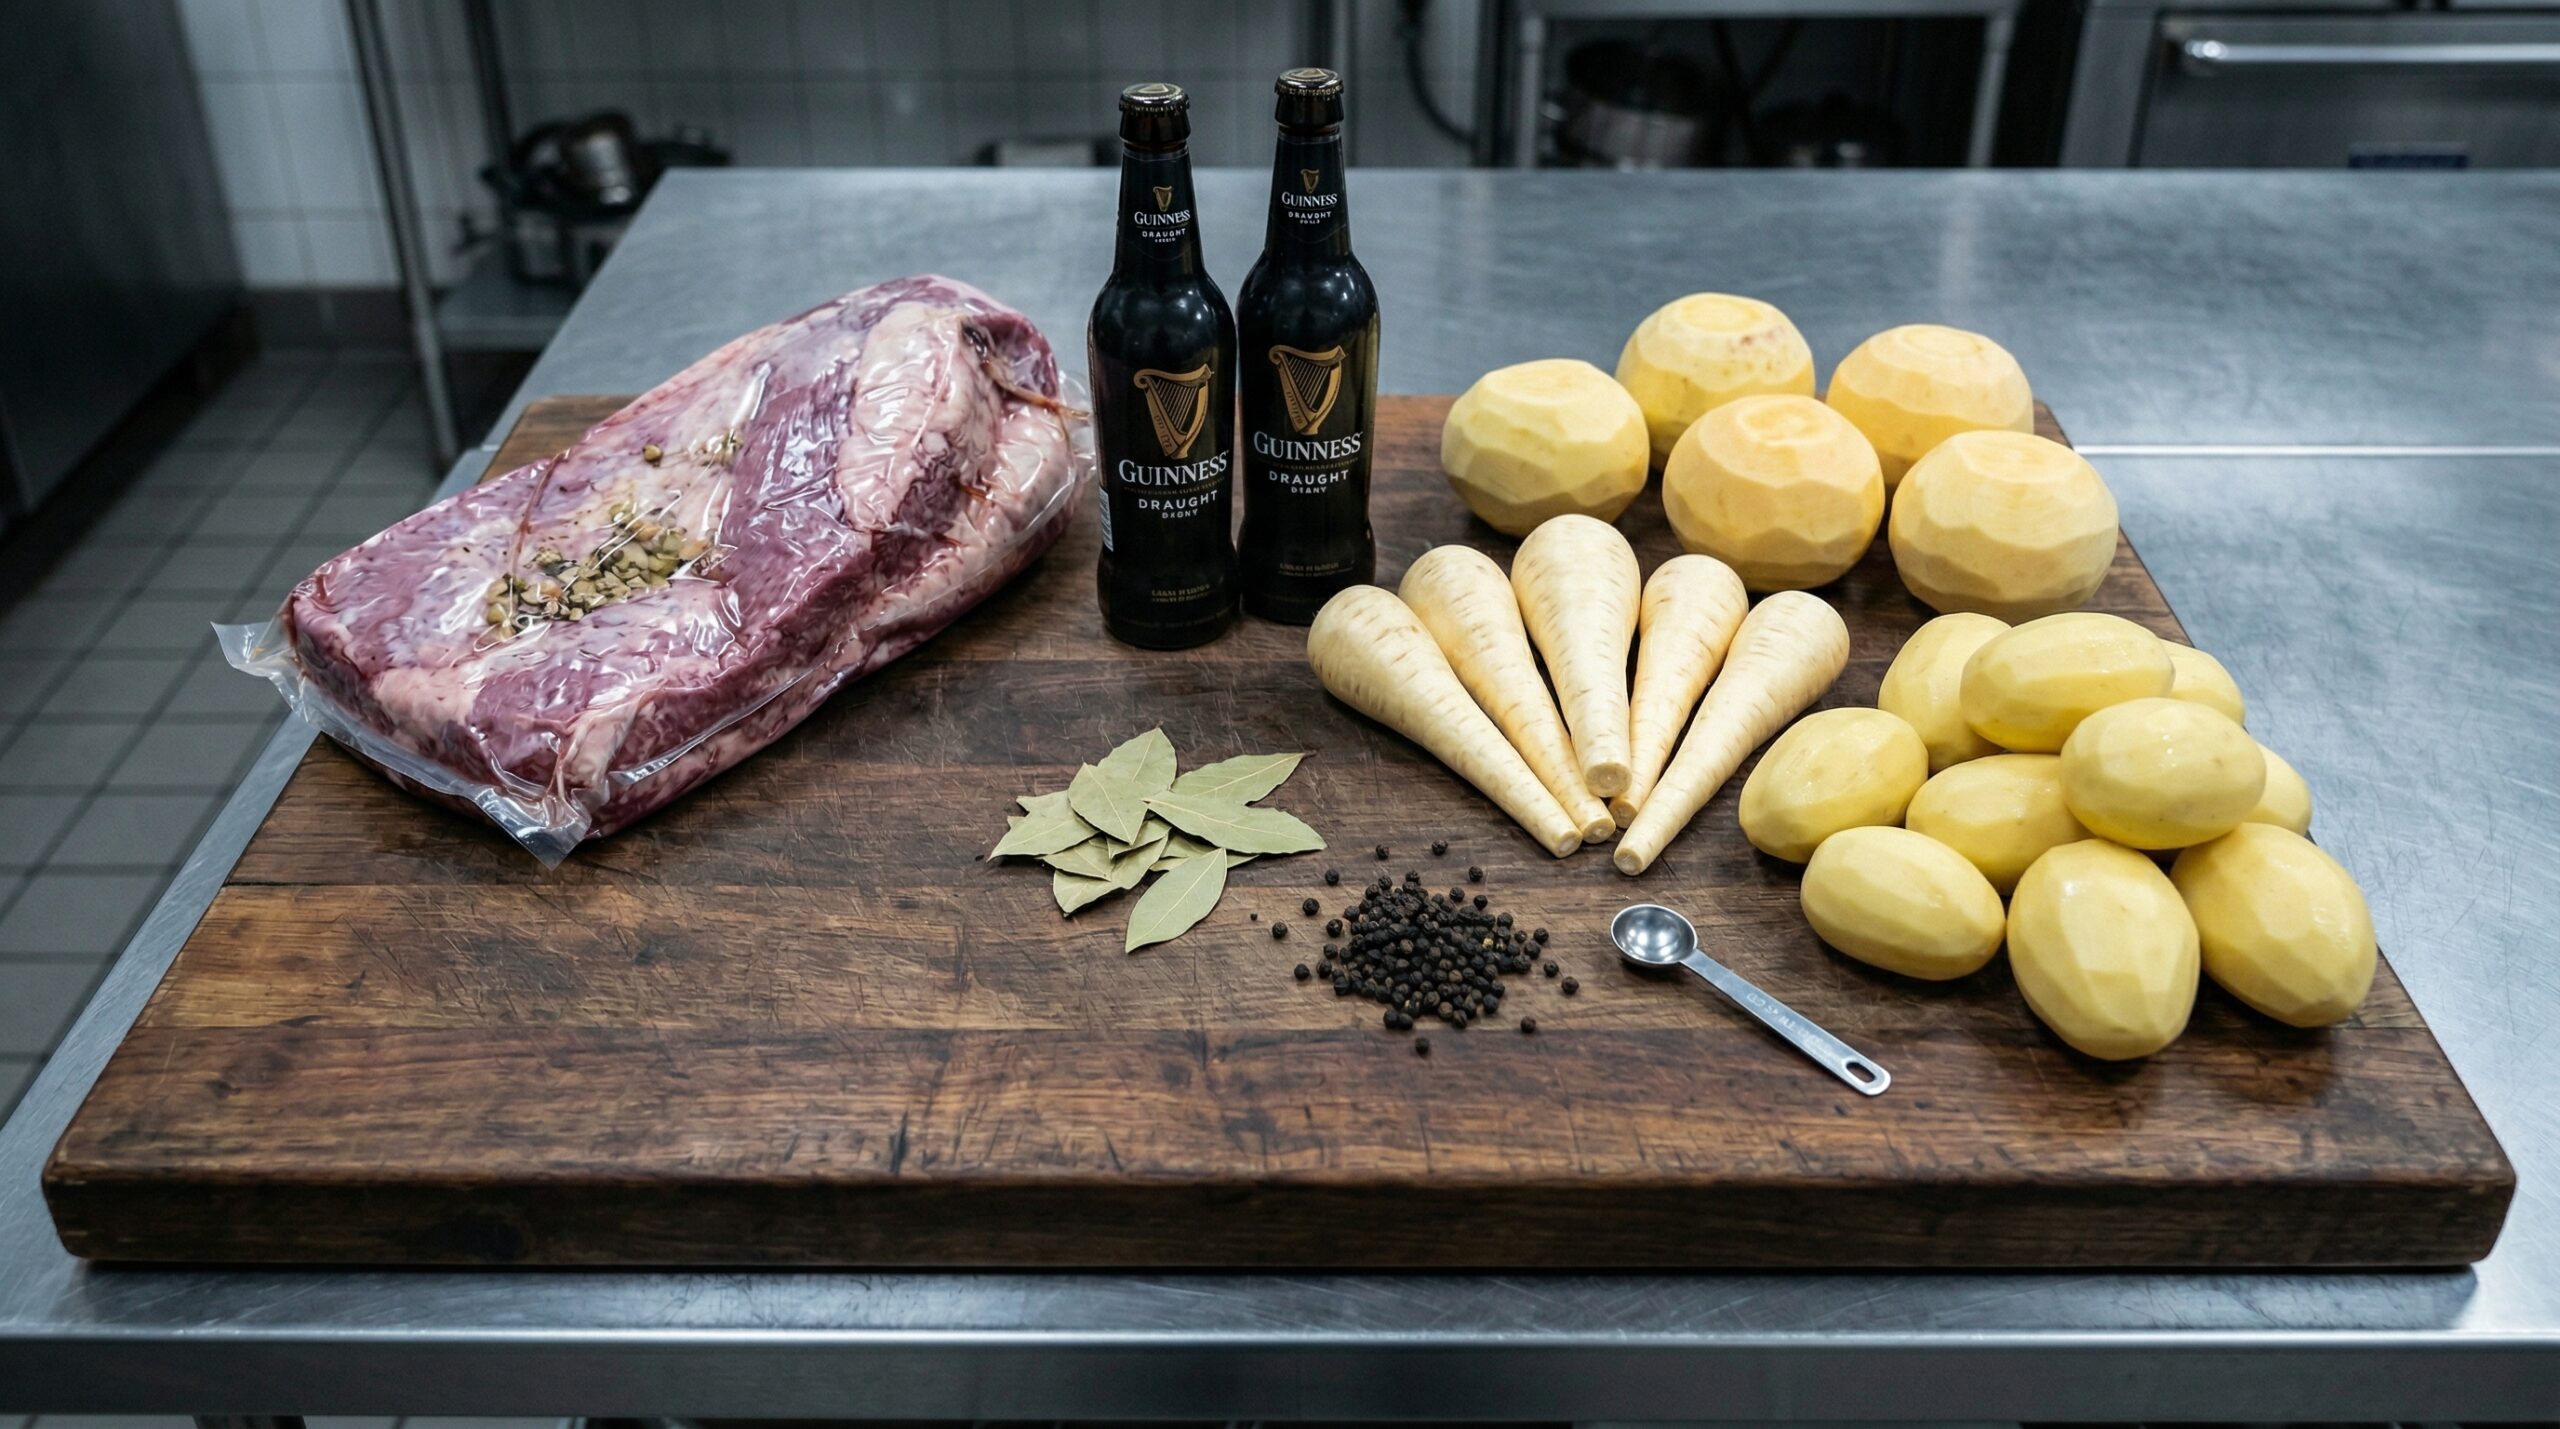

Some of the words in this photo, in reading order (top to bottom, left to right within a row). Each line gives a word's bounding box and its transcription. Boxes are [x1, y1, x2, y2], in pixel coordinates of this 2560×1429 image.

[1281, 191, 1338, 207] GUINNESS
[1134, 209, 1191, 226] GUINNESS
[1253, 430, 1362, 461] GUINNESS
[1118, 451, 1228, 486] GUINNESS
[1269, 469, 1349, 485] DRAUGHT
[1138, 489, 1218, 510] DRAUGHT
